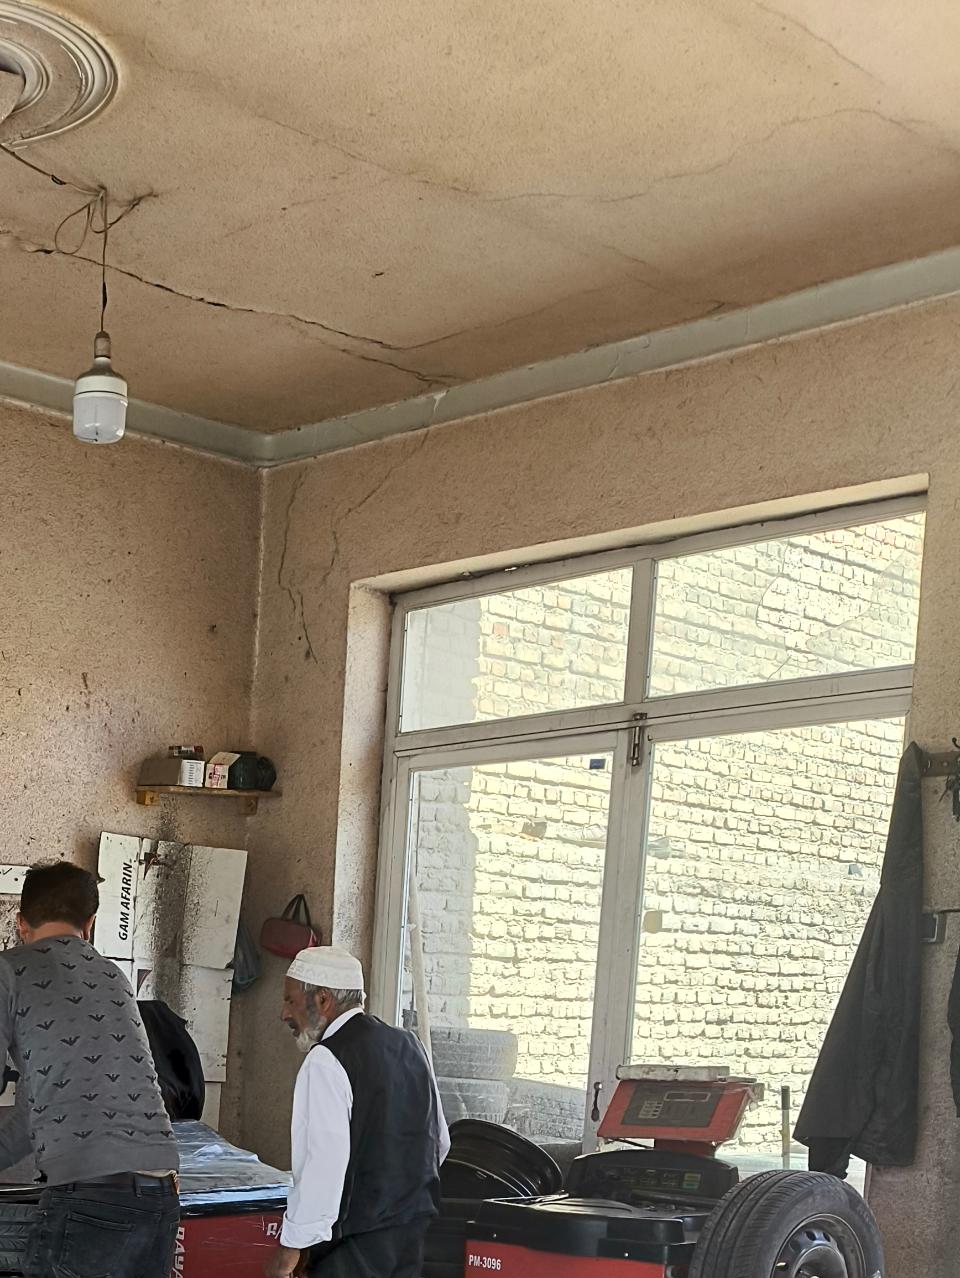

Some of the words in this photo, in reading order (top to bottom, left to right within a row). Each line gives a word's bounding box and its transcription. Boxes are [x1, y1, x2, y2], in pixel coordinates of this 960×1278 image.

[120, 862, 133, 911] AFARIN
[118, 911, 130, 941] GAM
[468, 1254, 502, 1271] PM-3096
